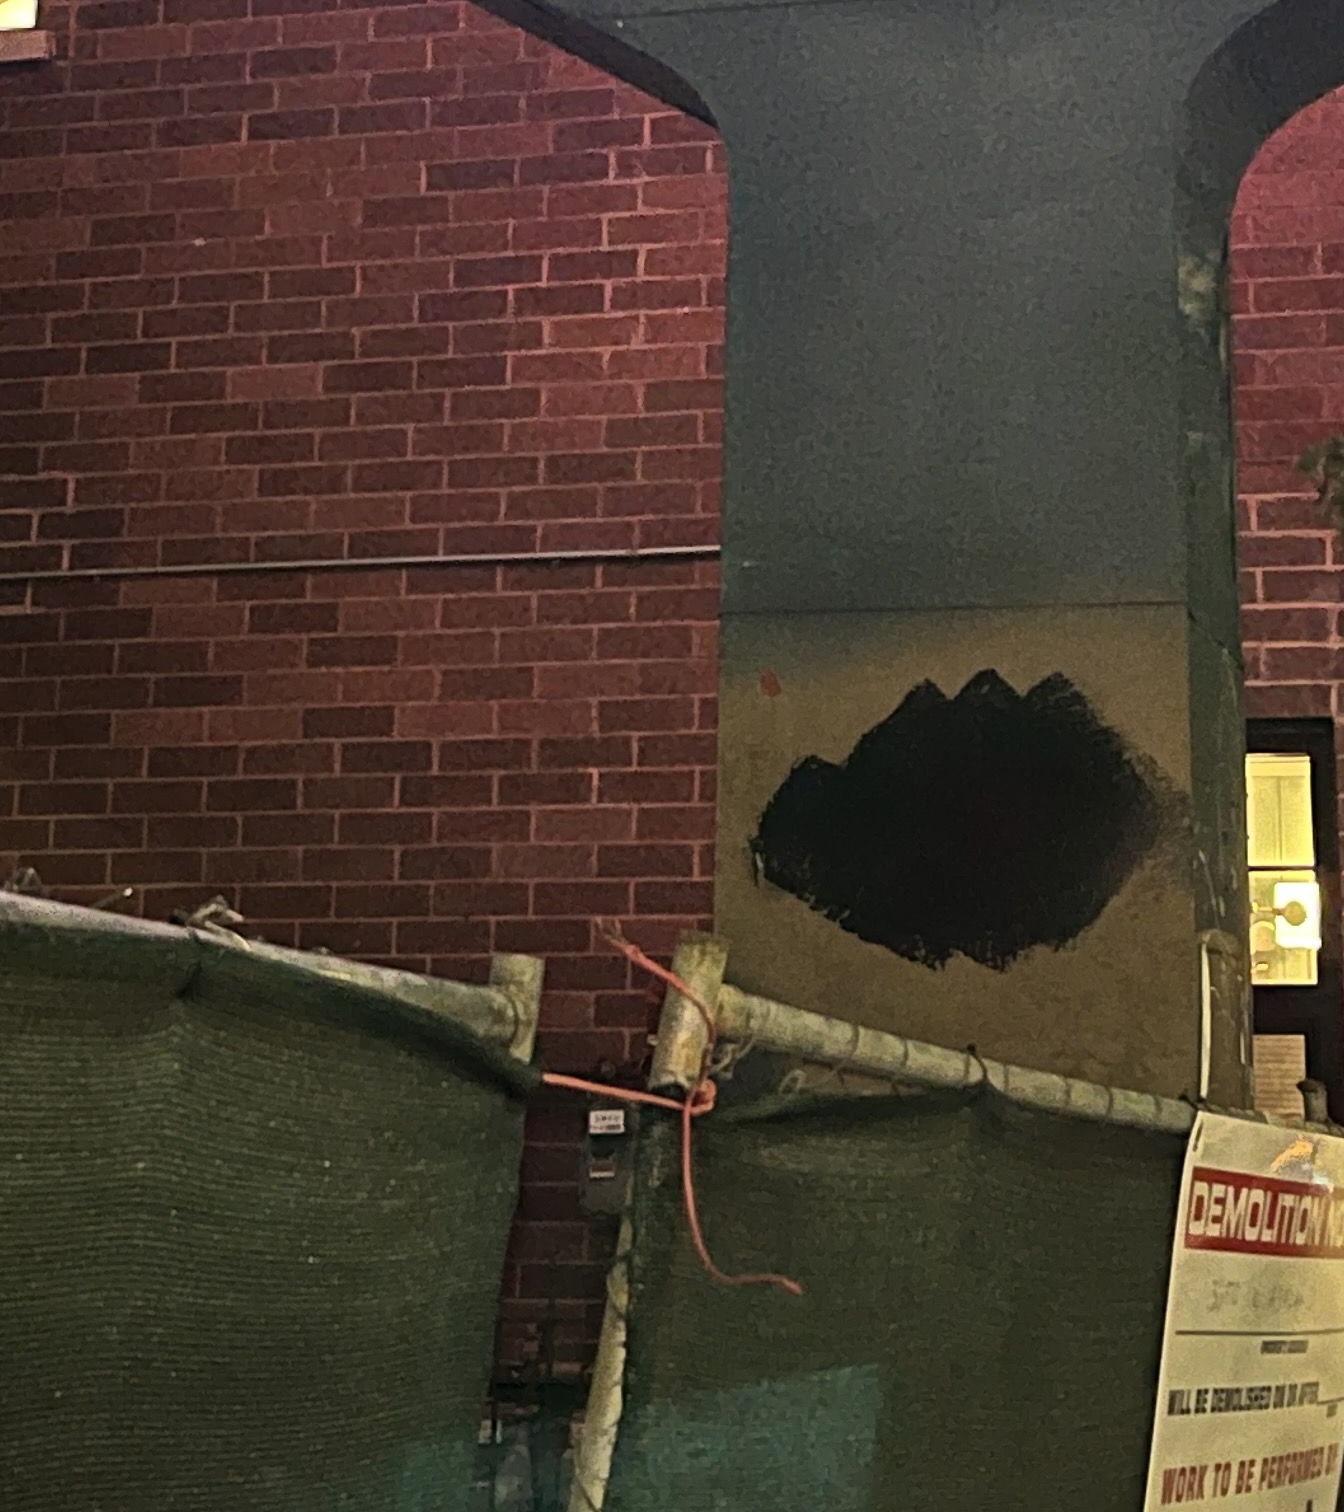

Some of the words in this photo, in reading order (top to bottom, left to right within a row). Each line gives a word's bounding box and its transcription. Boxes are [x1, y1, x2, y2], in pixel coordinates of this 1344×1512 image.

[1188, 1181, 1321, 1246] DEMOLITION
[1161, 1464, 1208, 1505] WORK
[1212, 1460, 1232, 1498] TO
[1235, 1458, 1257, 1495] BE
